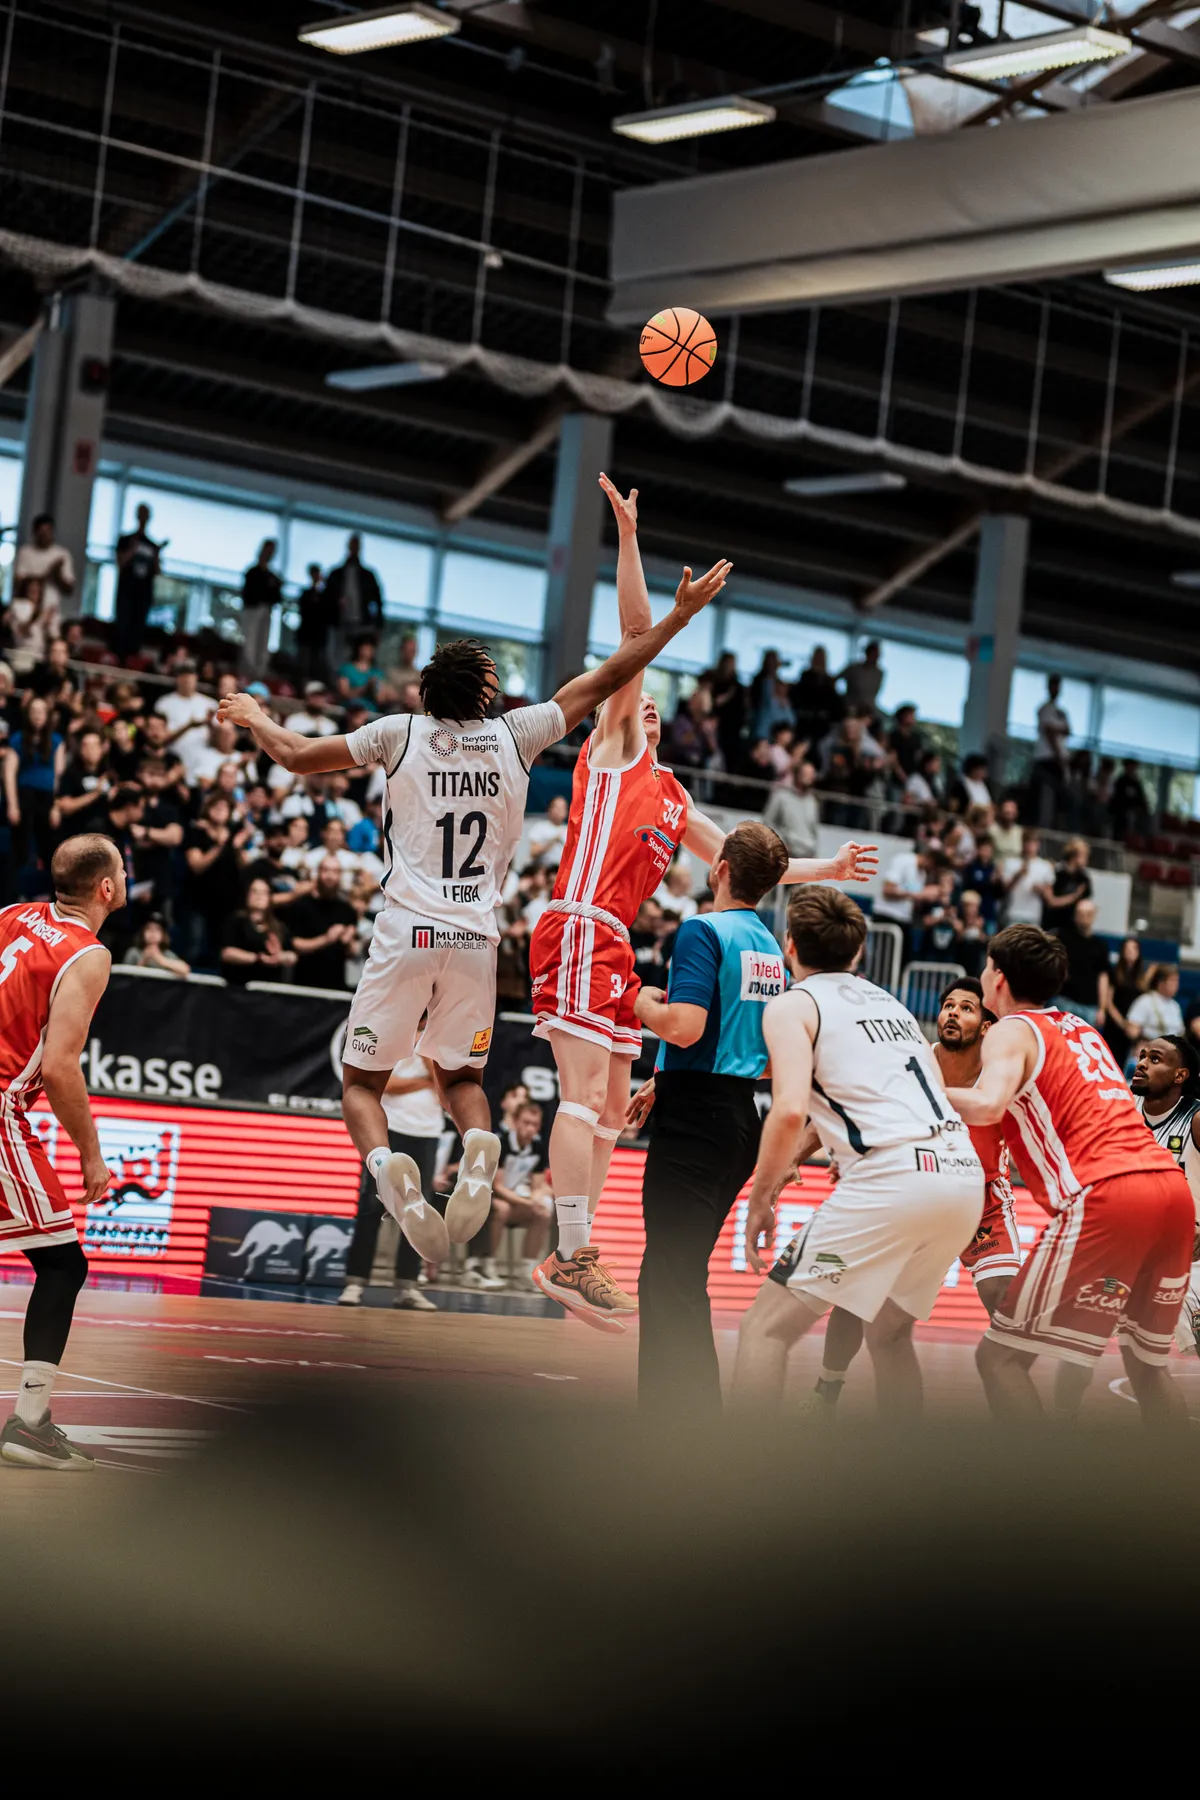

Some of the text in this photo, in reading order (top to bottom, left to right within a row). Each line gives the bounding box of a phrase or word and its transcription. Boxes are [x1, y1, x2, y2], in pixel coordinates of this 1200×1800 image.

[462, 734, 497, 744] Beyond
[462, 743, 499, 753] Imaging
[427, 771, 500, 797] TITANS
[663, 798, 684, 830] 34
[435, 811, 488, 879] 12
[435, 941, 488, 950] IMMOBILIEN
[436, 931, 487, 941] MUNDUS
[610, 973, 628, 999] 3
[856, 1018, 922, 1044] TITANS
[351, 1038, 377, 1056] GWG
